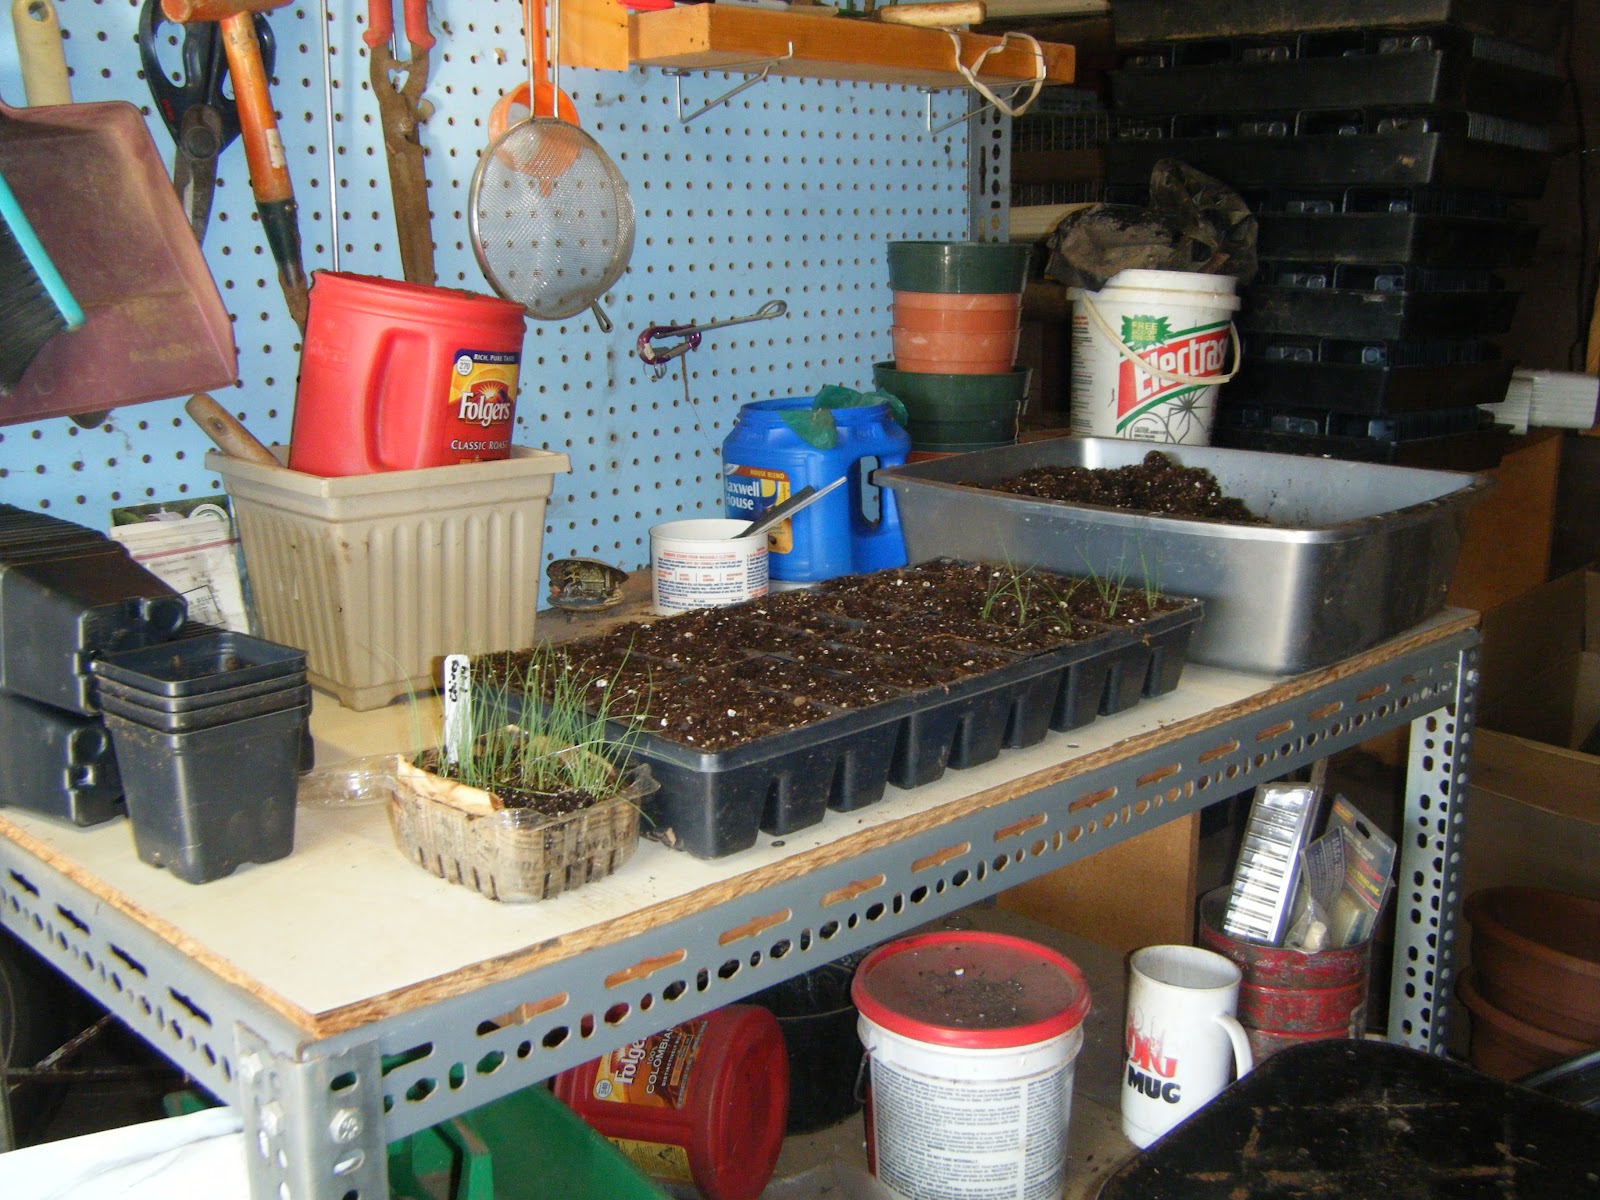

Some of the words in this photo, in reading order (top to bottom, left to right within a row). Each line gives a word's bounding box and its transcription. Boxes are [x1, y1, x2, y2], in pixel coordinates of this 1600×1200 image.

[1131, 321, 1158, 330] FREE
[490, 354, 503, 362] PURE
[459, 362, 471, 371] 270
[458, 391, 511, 428] Folgers
[451, 440, 486, 451] CLASSIC
[488, 441, 509, 450] ROAST
[750, 469, 767, 478] HOUSE
[767, 471, 785, 479] BLEND
[726, 480, 760, 498] axwell
[613, 1037, 648, 1085] Folge
[646, 1045, 659, 1065] 100%
[1128, 1065, 1181, 1104] MUG
